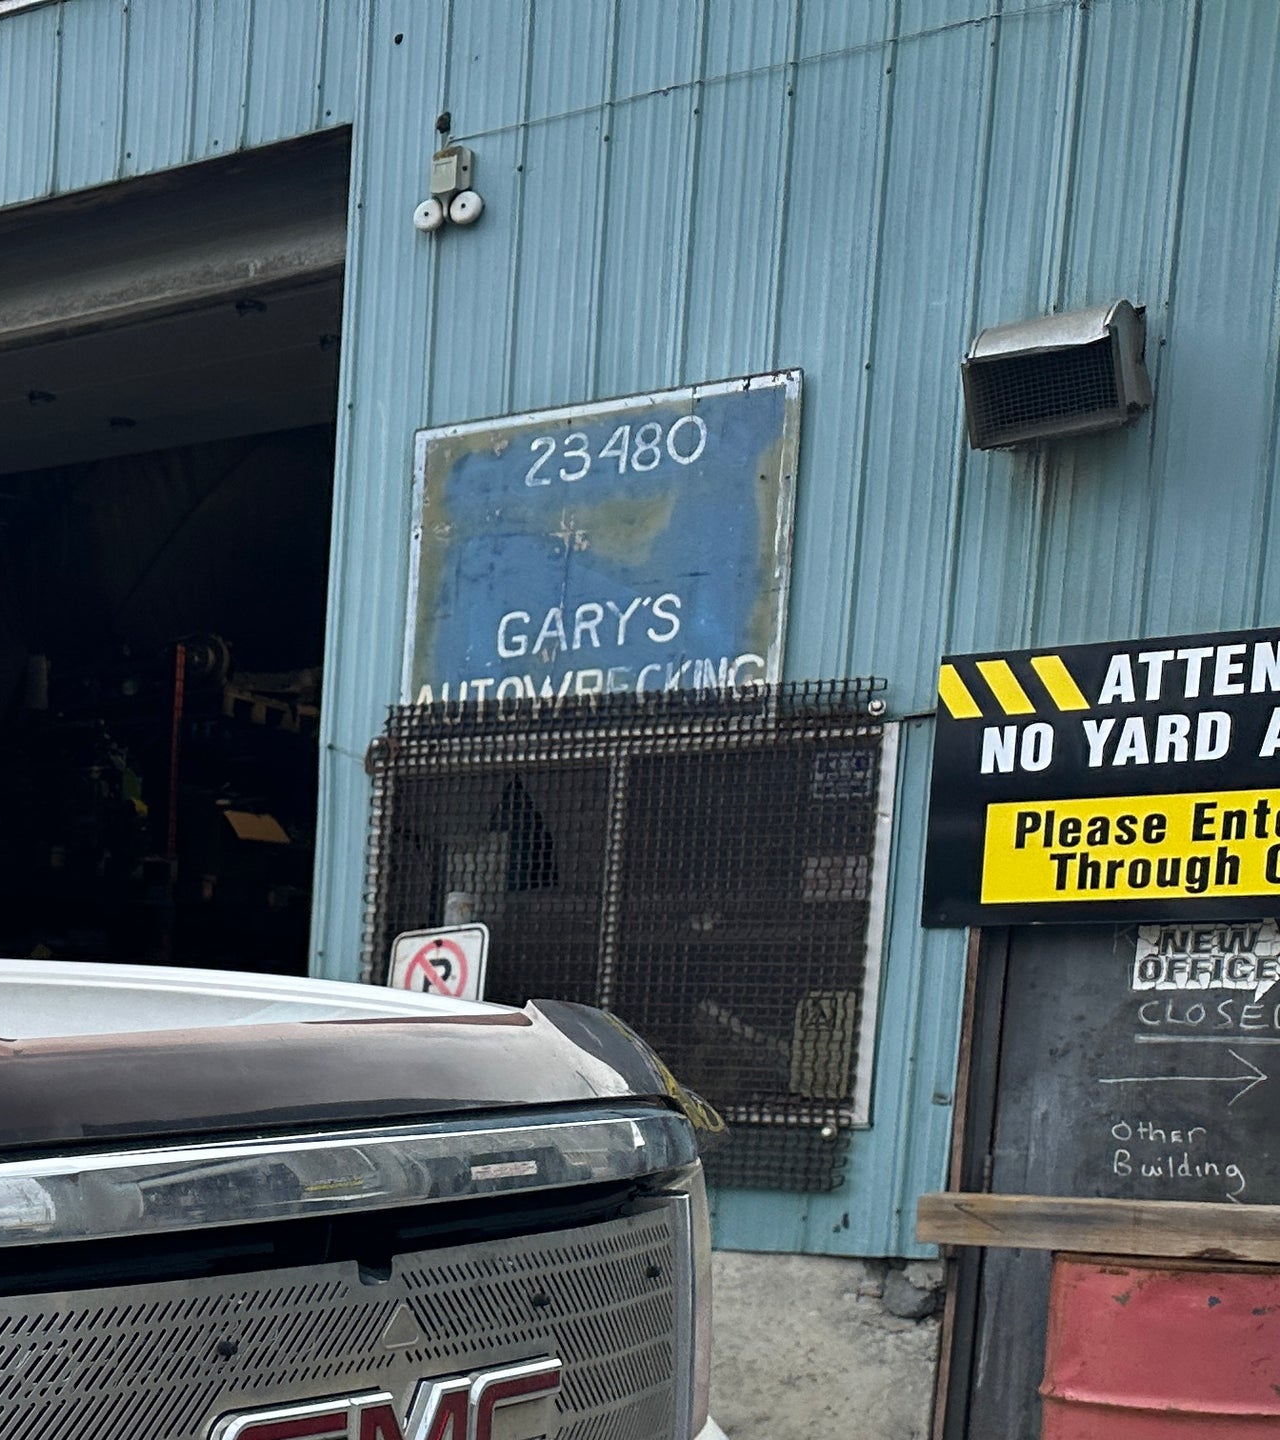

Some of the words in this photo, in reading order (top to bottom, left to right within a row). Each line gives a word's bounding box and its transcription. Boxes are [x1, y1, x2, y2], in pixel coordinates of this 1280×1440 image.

[525, 414, 708, 488] 23480
[496, 592, 682, 659] GARY'S
[413, 653, 767, 722] AUTOWRECKING
[1097, 640, 1280, 705] ATTEN
[980, 721, 1055, 775] NO
[1082, 710, 1232, 768] YARD
[1014, 809, 1168, 849] Please
[1191, 798, 1280, 843] Ent
[1049, 845, 1241, 894] Through
[1159, 927, 1260, 955] NEW
[1138, 956, 1280, 981] OFFICE
[1137, 998, 1280, 1031] CLOSE
[1111, 1120, 1207, 1144] Other
[1113, 1148, 1246, 1197] Building
